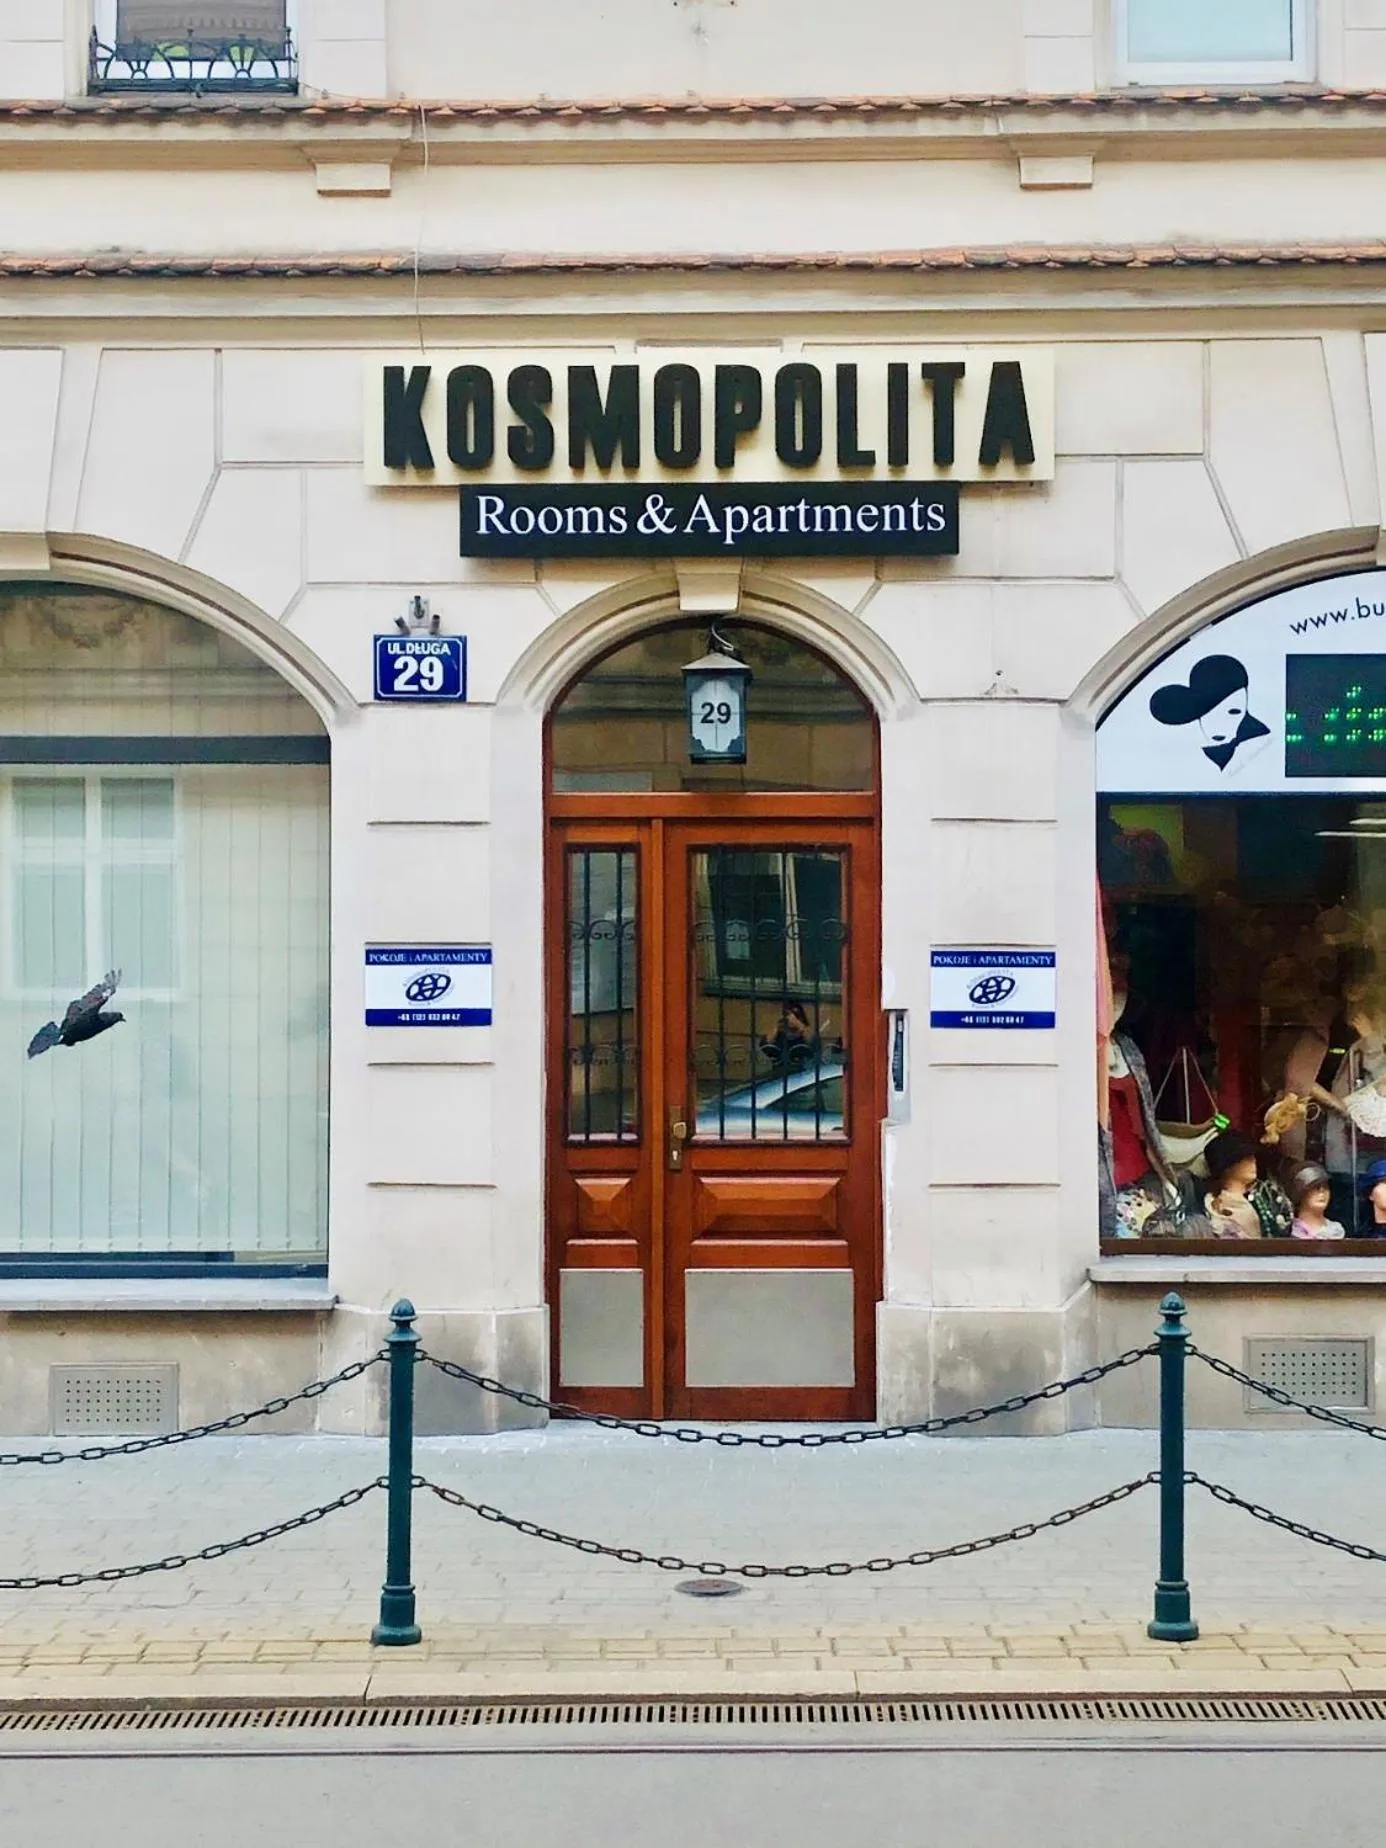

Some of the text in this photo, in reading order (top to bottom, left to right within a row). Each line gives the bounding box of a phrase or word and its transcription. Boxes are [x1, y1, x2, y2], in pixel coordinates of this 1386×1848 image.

[382, 361, 1036, 470] KOSMOPOLITA
[476, 493, 947, 544] Rooms & Apartments
[394, 656, 444, 692] 29
[700, 702, 732, 724] 29
[369, 953, 406, 962] POKOJE
[414, 952, 488, 962] APARTAMENTY
[933, 955, 971, 965] POKOJE
[978, 955, 1053, 965] APARTAMENTY
